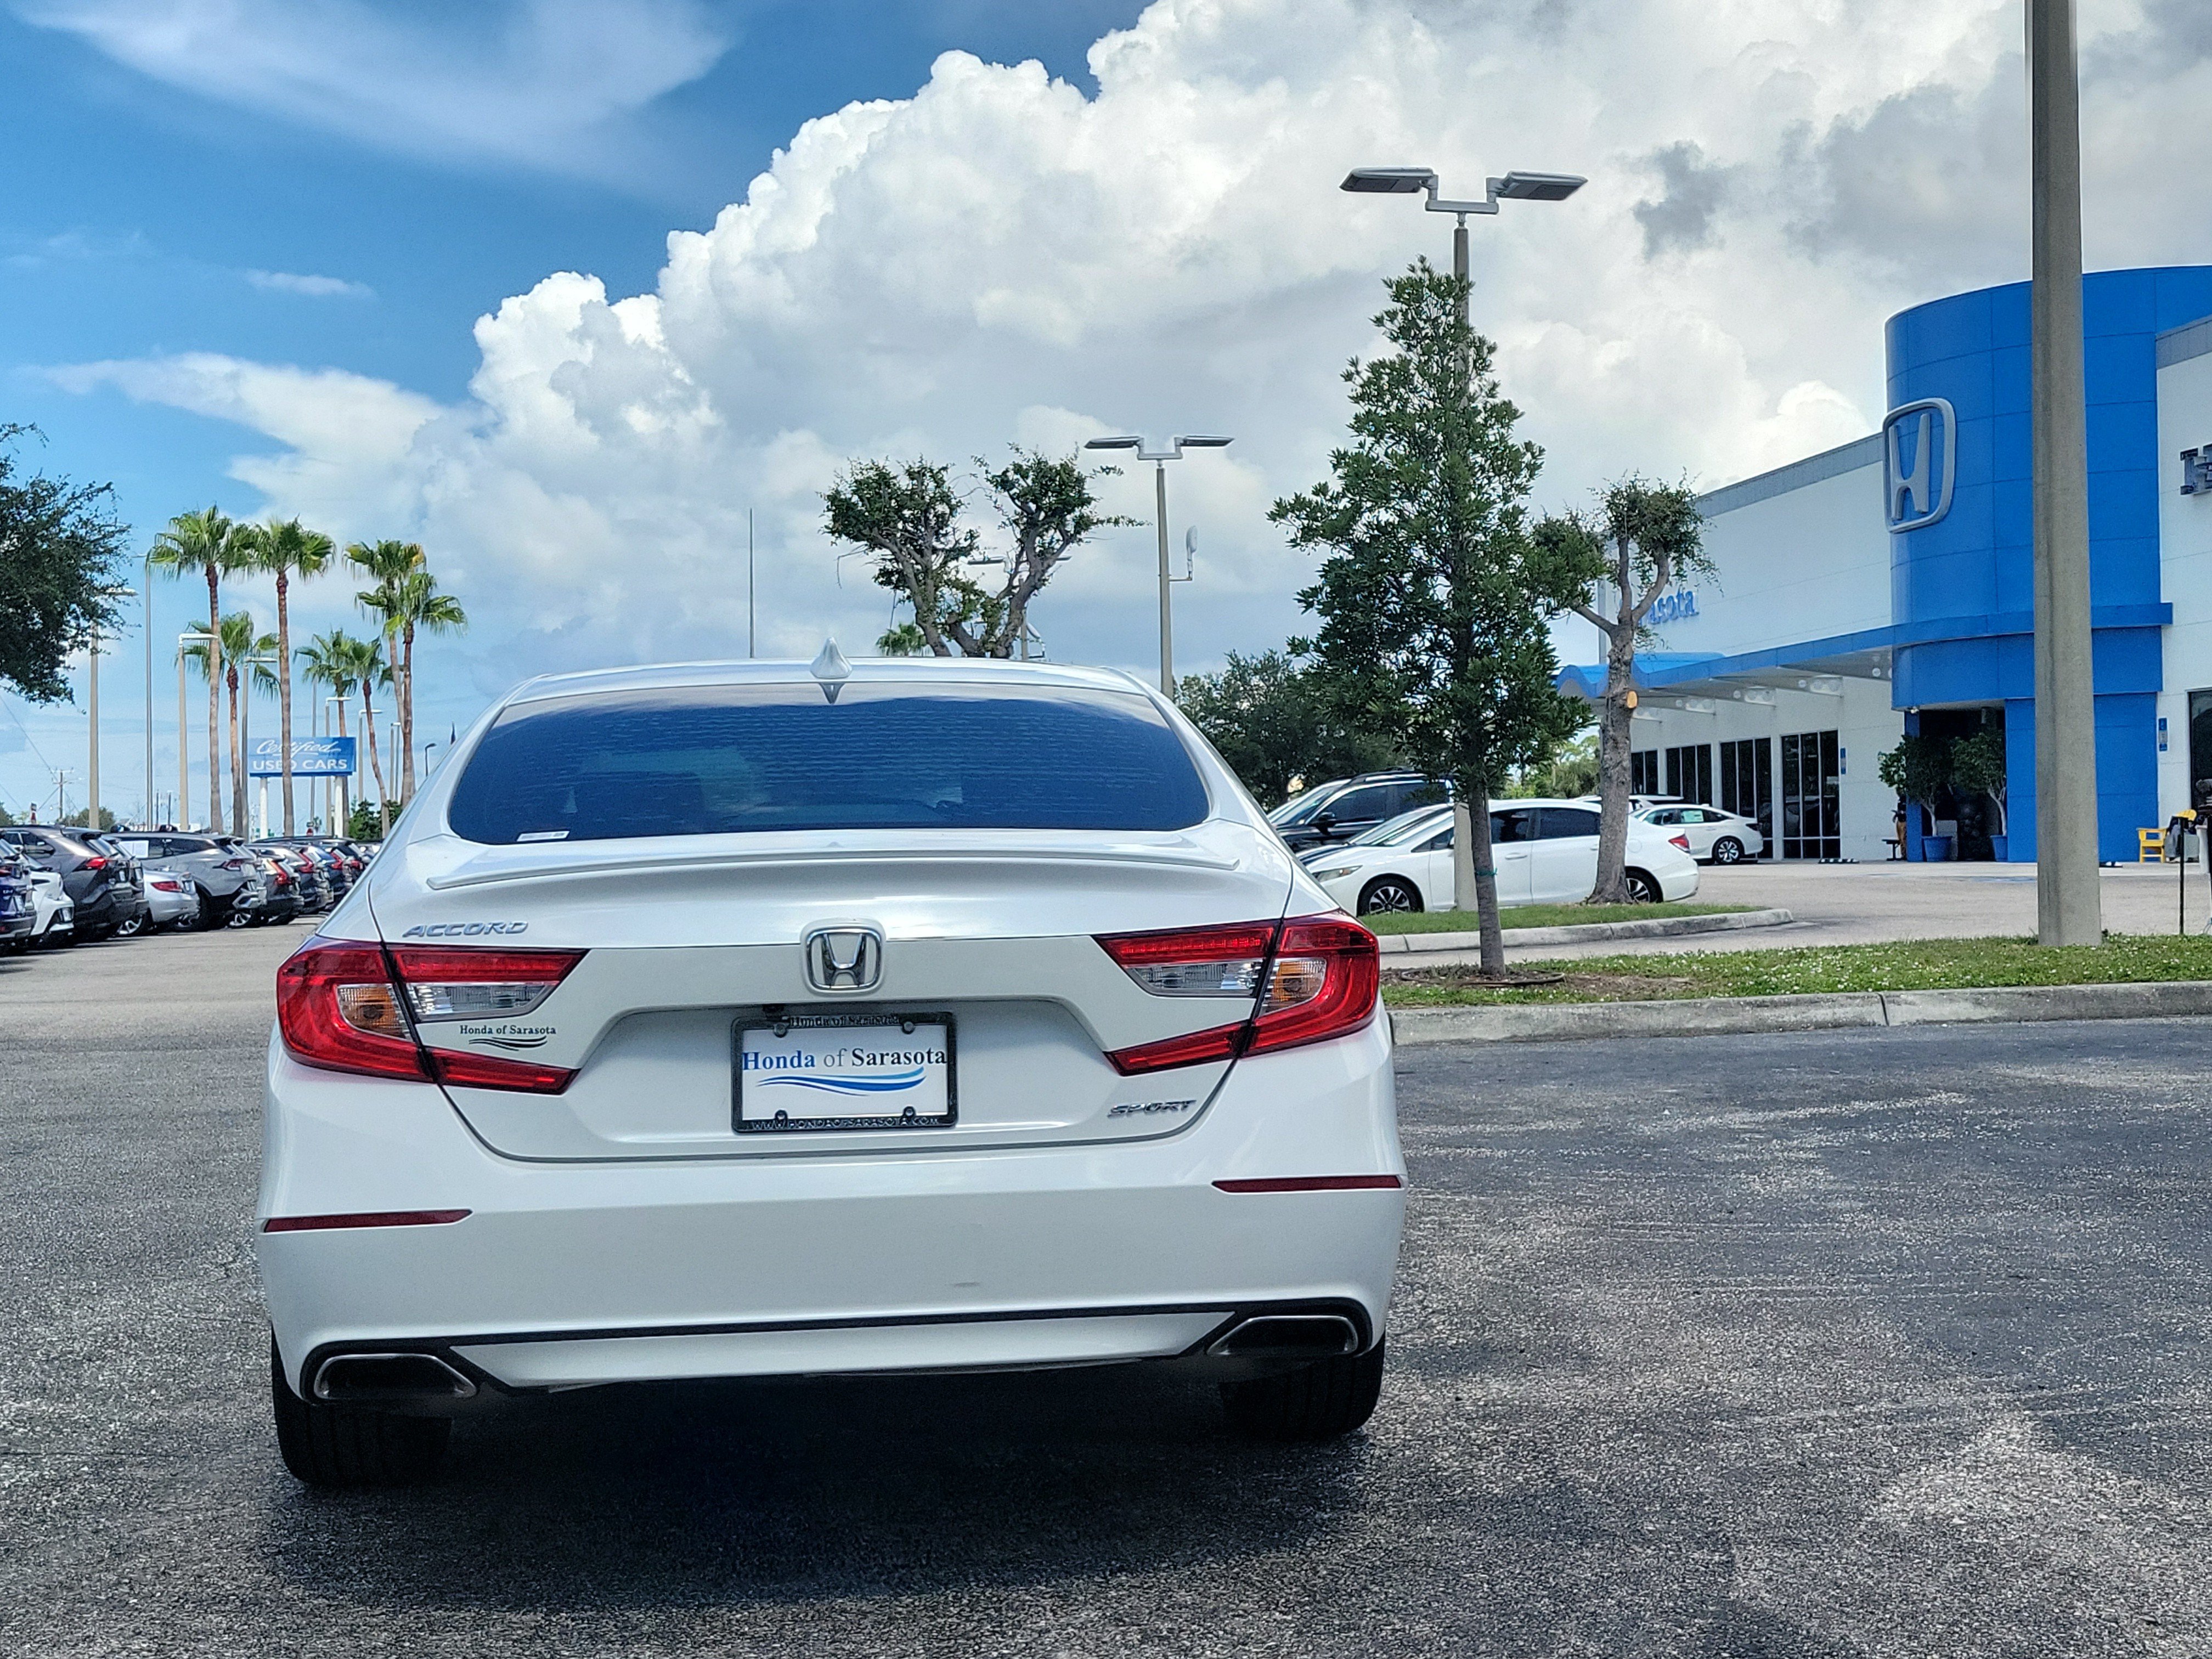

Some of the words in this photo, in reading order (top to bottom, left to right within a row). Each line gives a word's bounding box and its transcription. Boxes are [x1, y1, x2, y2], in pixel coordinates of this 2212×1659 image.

[302, 758, 347, 770] CARS
[402, 921, 528, 938] ACCORD
[460, 1024, 493, 1035] Honda
[496, 1025, 507, 1034] of
[509, 1024, 556, 1035] Sarasota
[742, 1050, 816, 1070] Honda
[823, 1047, 848, 1067] of
[851, 1047, 947, 1066] Sarasota
[1107, 1100, 1197, 1118] SPORT
